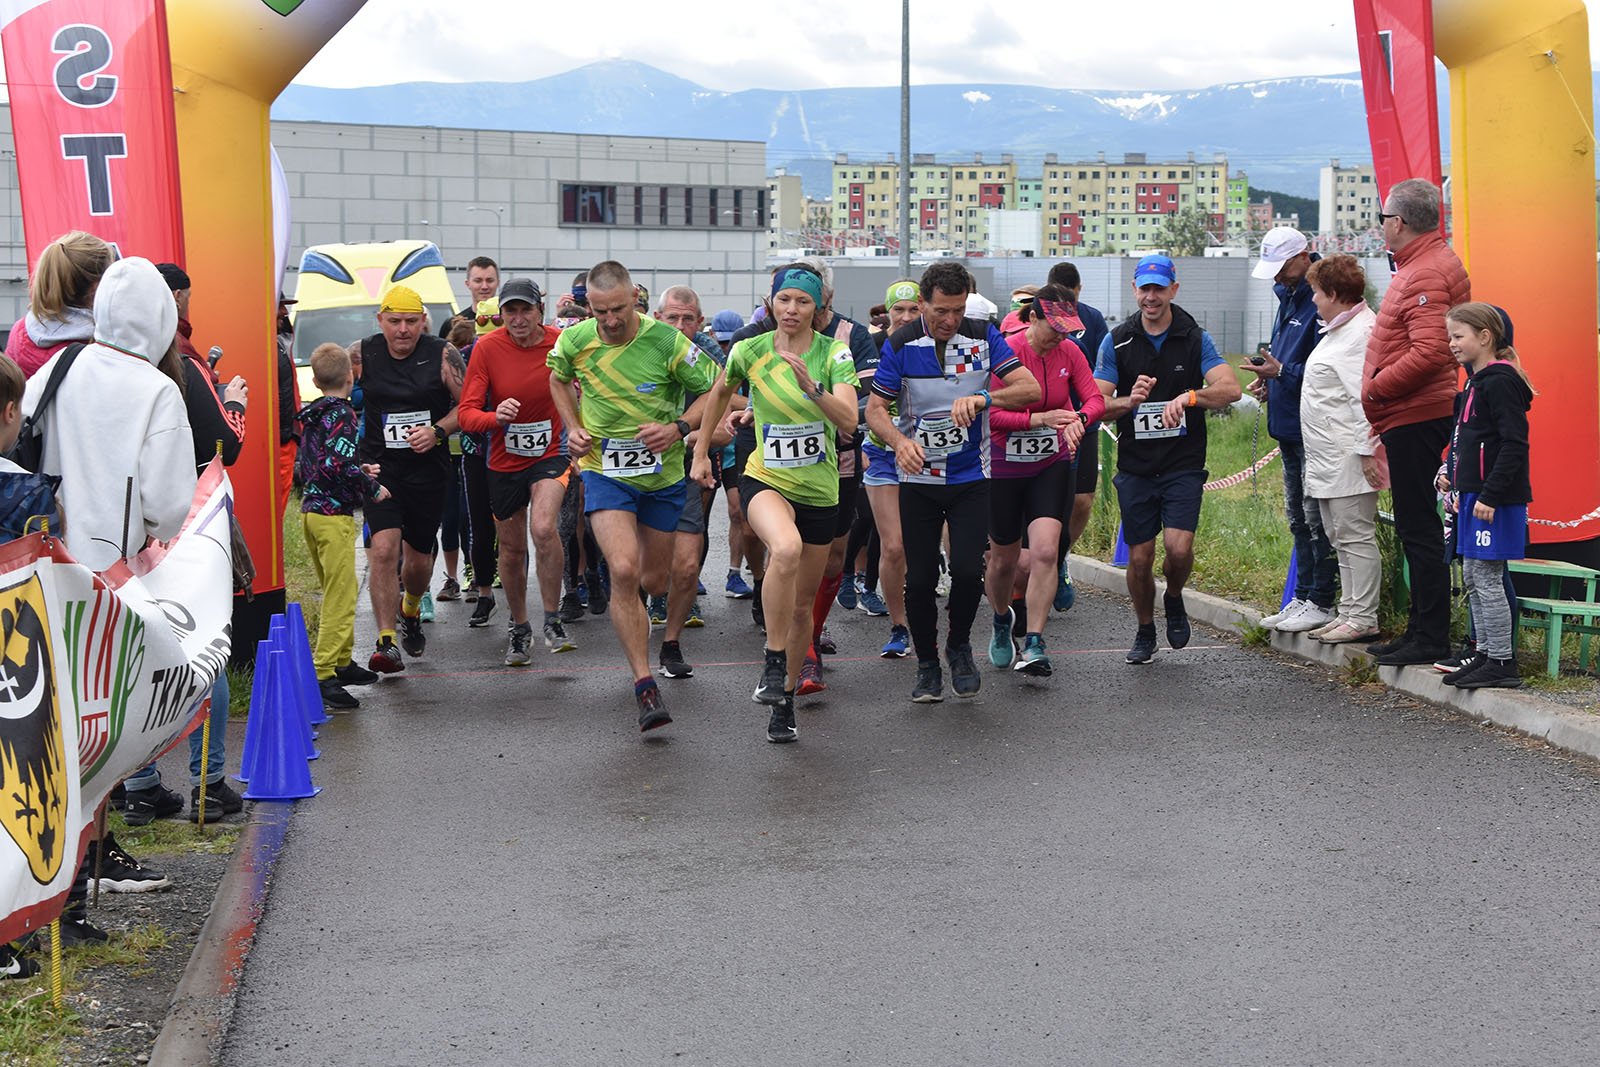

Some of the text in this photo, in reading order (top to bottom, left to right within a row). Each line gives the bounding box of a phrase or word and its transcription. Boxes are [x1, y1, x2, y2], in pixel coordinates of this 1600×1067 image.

[1139, 414, 1180, 430] 13
[388, 423, 426, 441] 13
[510, 432, 548, 449] 134
[919, 427, 964, 447] 133
[770, 436, 820, 458] 118
[1012, 437, 1054, 454] 132
[608, 449, 656, 467] 123
[1475, 530, 1491, 546] 26
